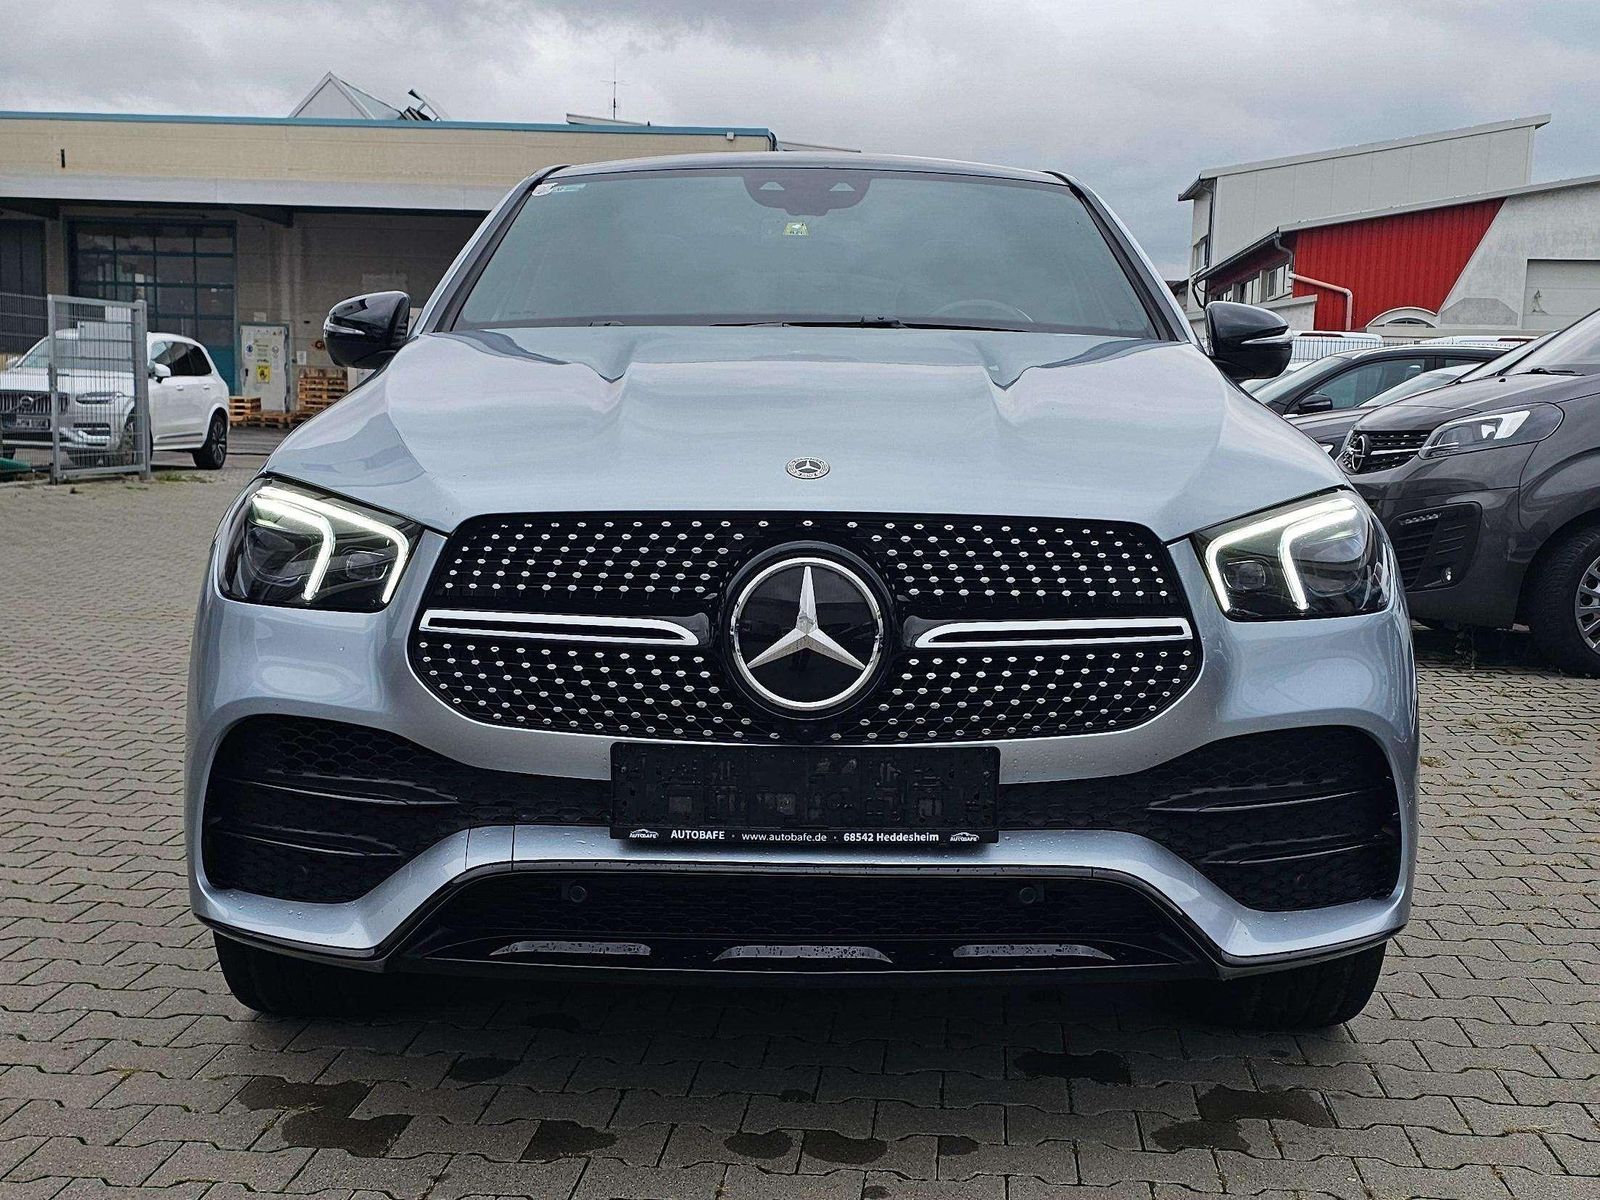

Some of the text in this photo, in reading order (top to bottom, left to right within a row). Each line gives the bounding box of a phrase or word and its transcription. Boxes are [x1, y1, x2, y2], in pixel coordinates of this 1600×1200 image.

[670, 830, 939, 842] AUTOBAFE www.autobafe.de 68542 Heddesheim
